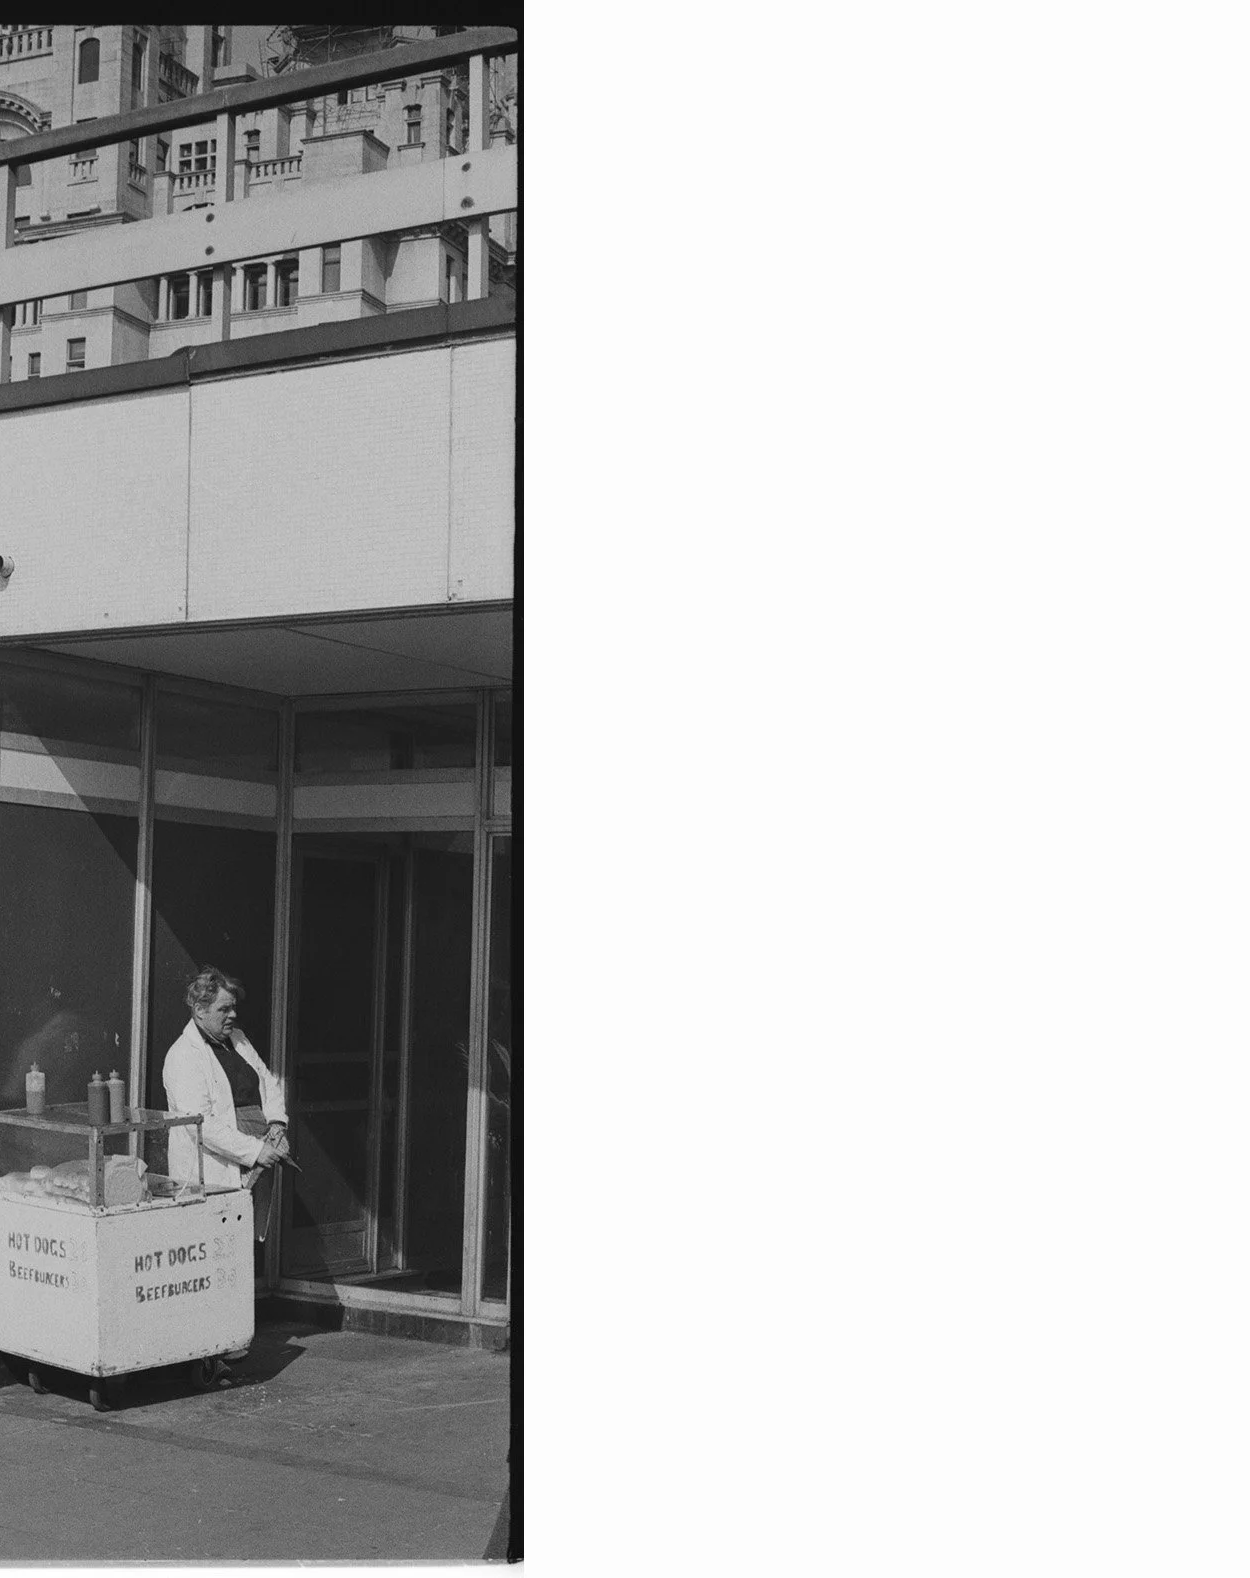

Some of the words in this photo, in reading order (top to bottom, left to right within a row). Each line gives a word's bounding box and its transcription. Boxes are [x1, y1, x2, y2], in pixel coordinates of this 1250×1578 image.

[8, 1231, 30, 1251] HOT
[34, 1235, 66, 1258] DOGS
[134, 1250, 163, 1273] HOT
[168, 1242, 207, 1268] DOGS
[135, 1275, 211, 1303] BEEFBURGERS
